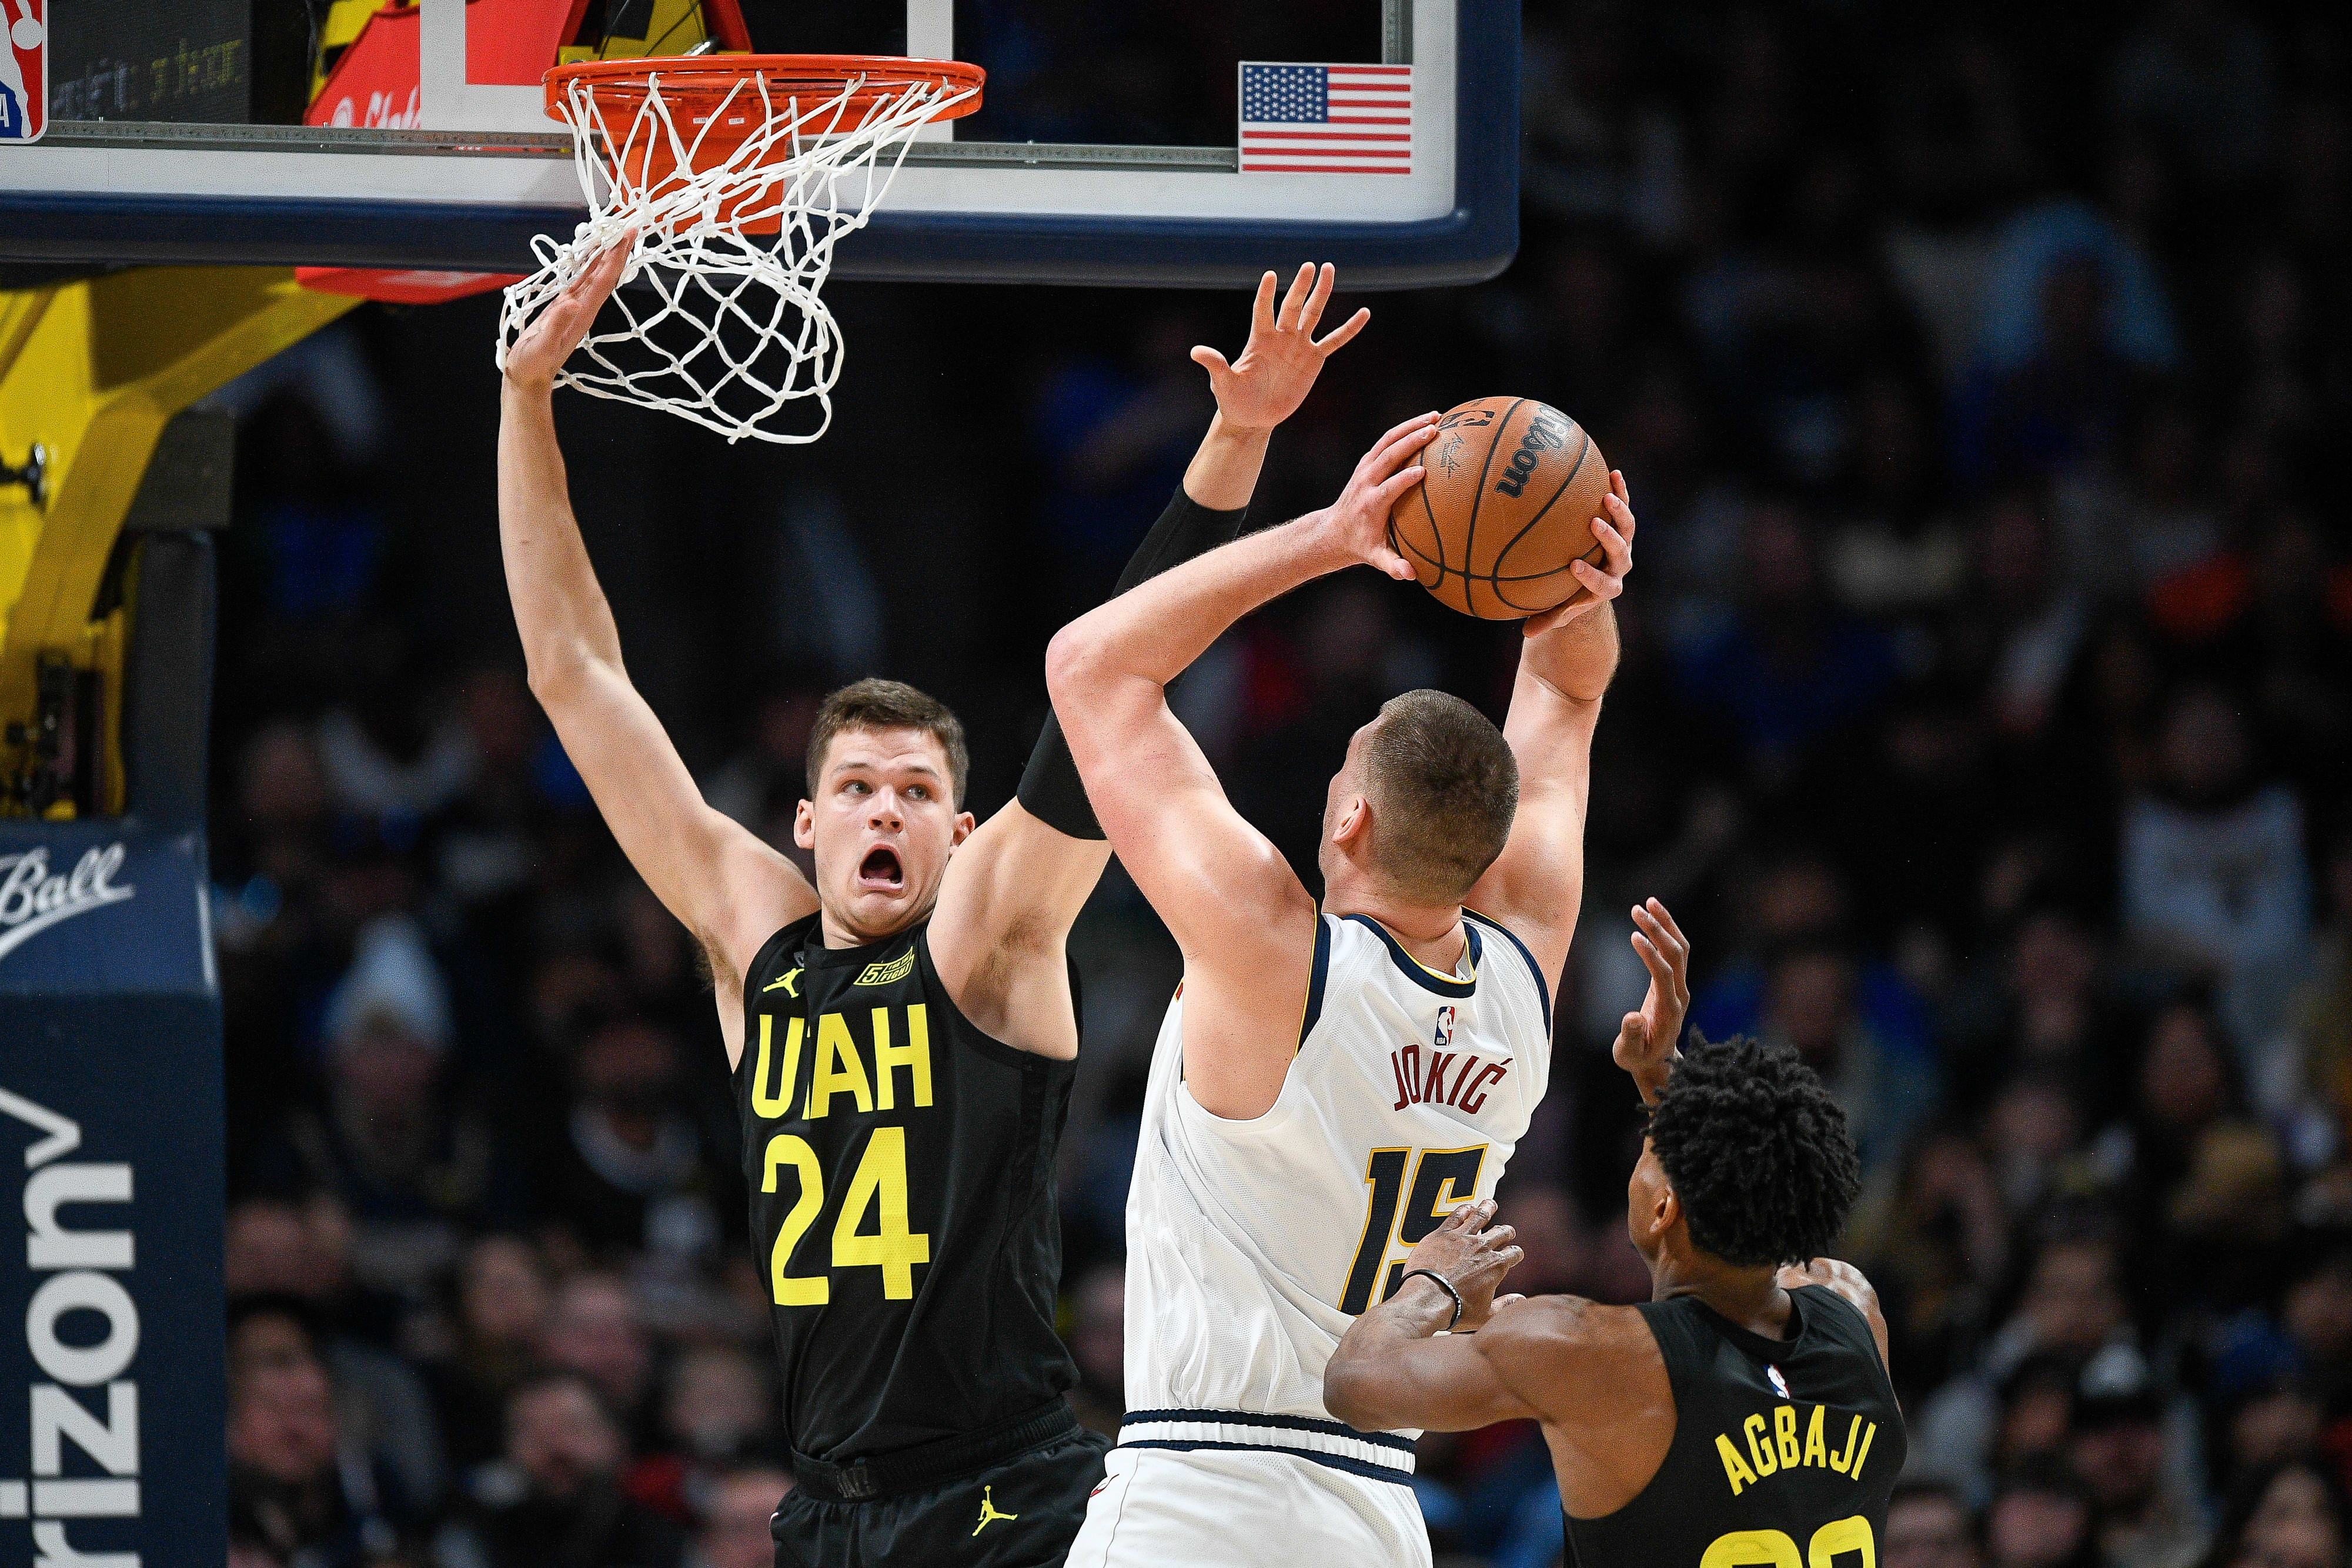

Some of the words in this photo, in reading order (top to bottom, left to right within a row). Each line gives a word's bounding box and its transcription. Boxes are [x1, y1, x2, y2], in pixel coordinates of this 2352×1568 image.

[0, 842, 136, 924] Ball
[862, 967, 883, 983] 5
[751, 1003, 933, 1120] UAH
[1392, 1044, 1513, 1115] JOKIĆ
[761, 1126, 929, 1306] 24
[1715, 1405, 1876, 1496] AGBAJI
